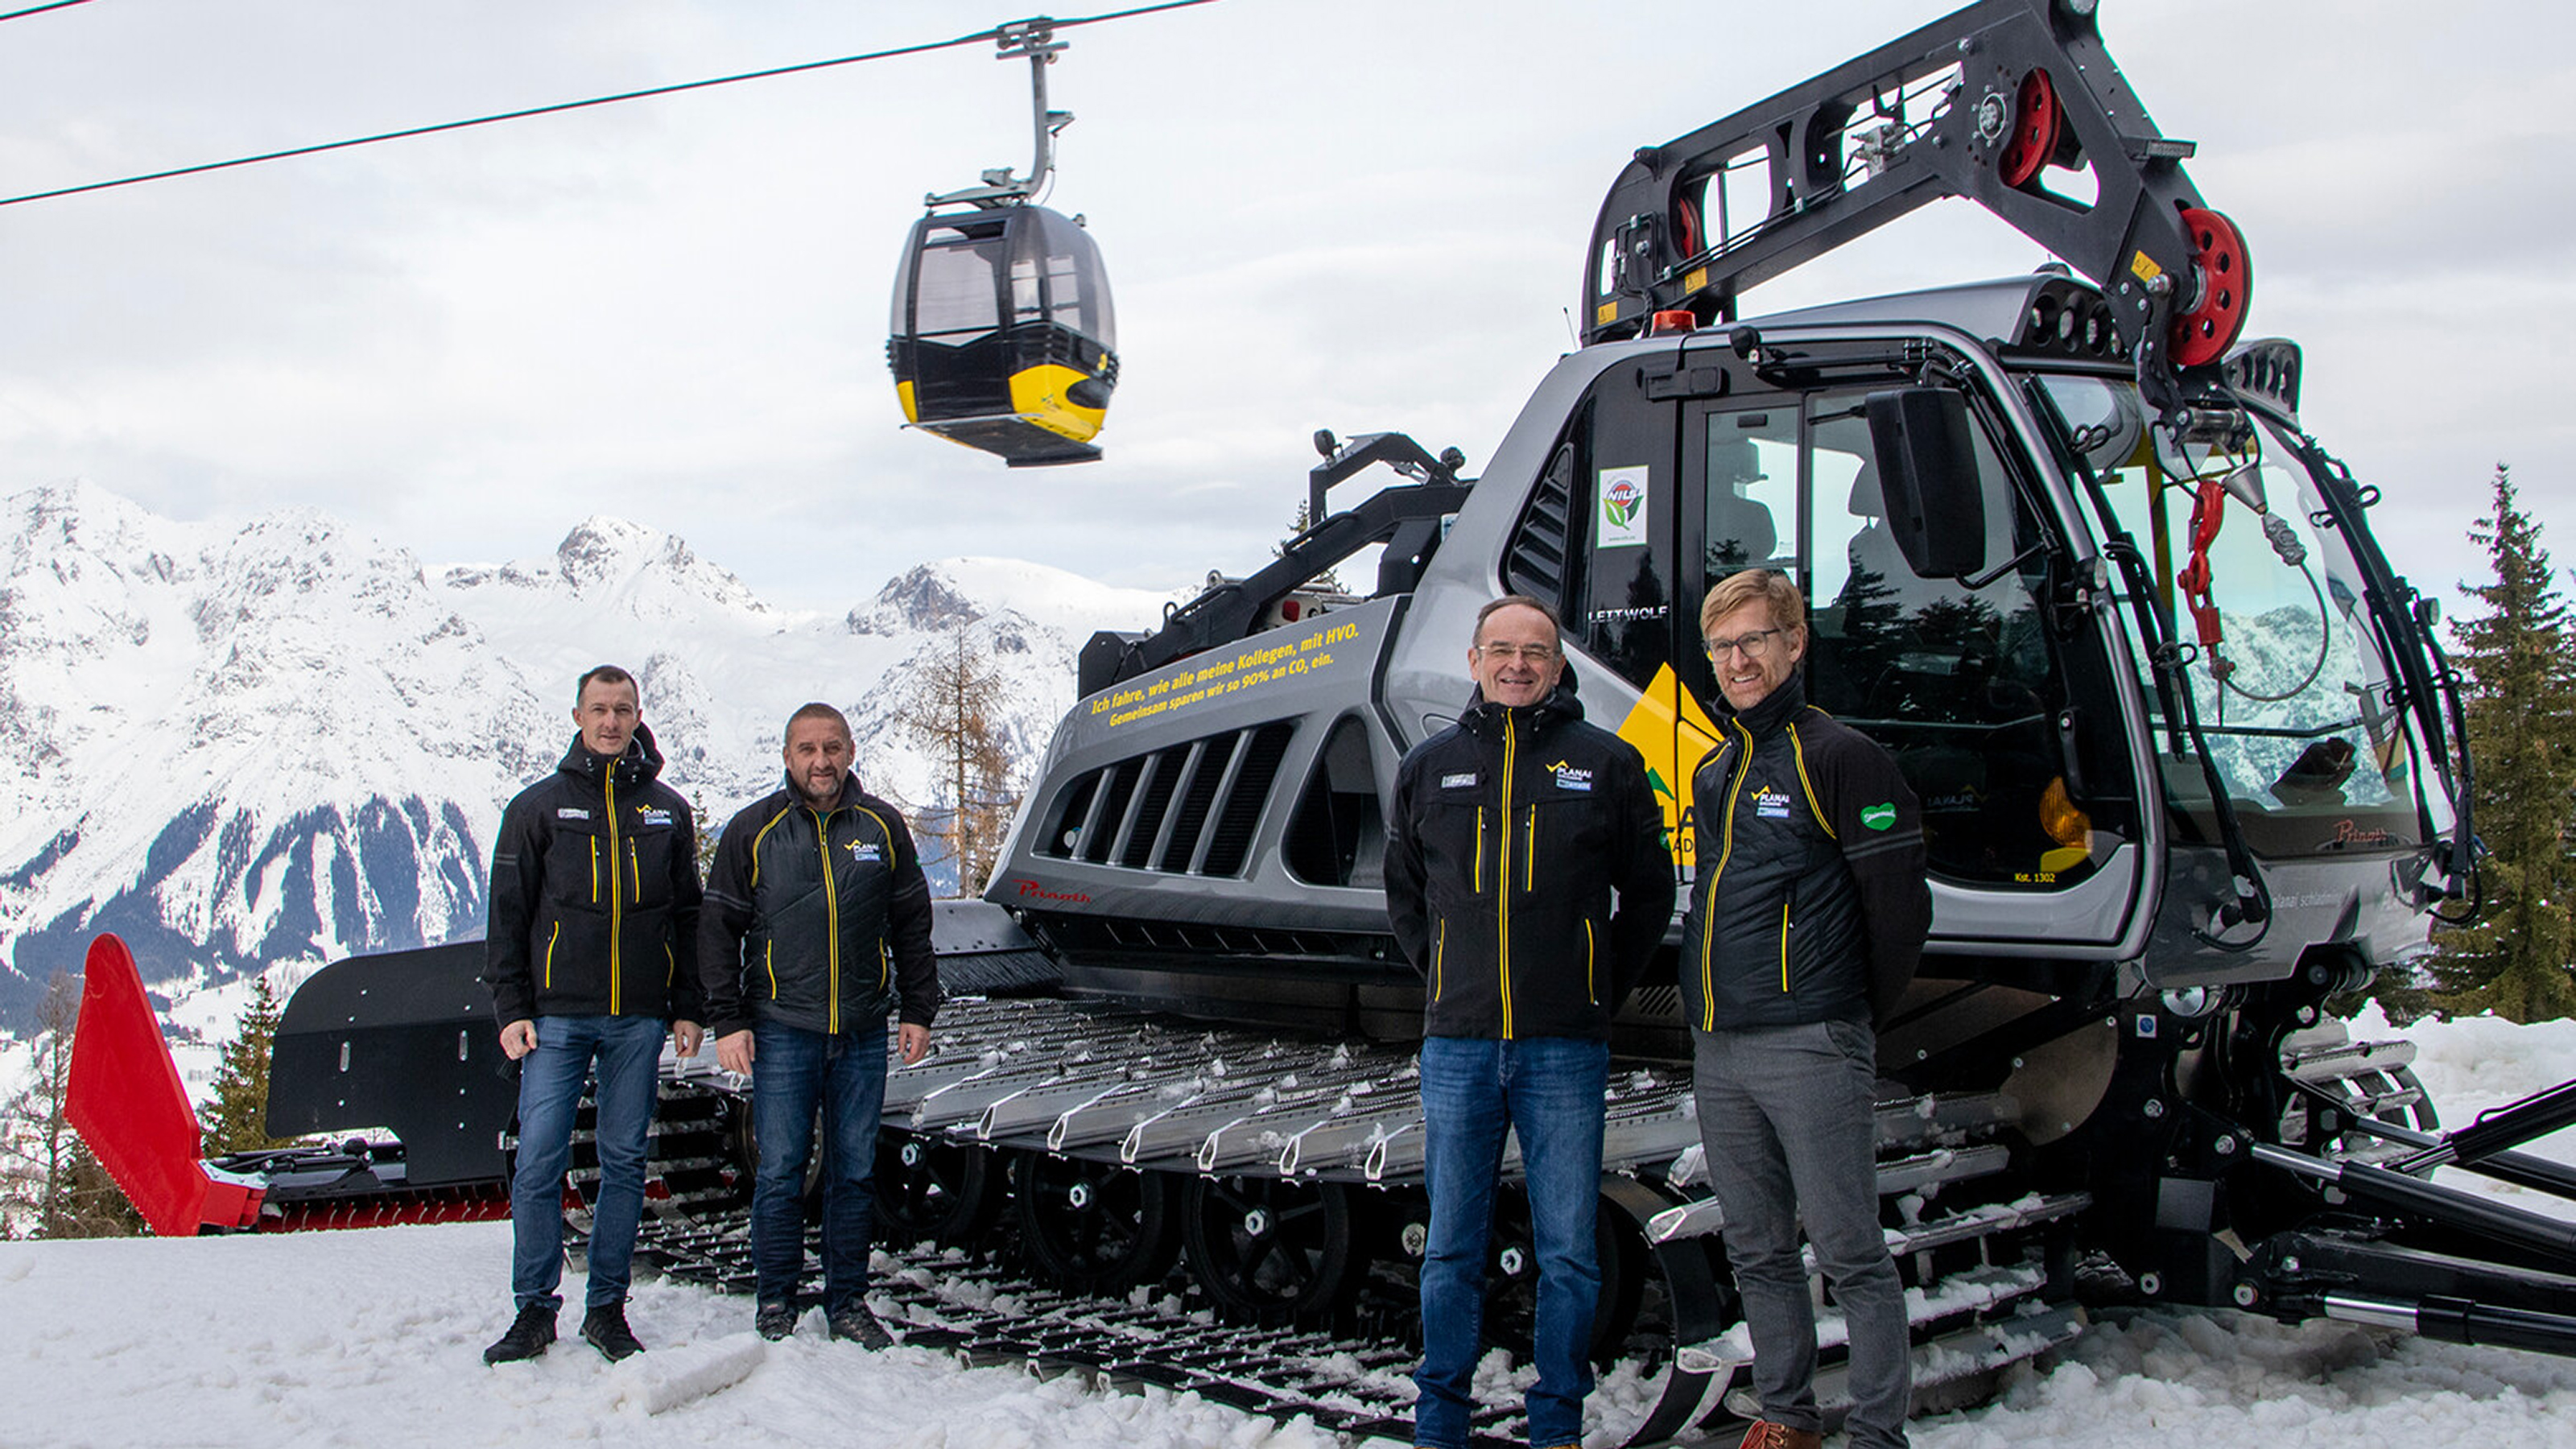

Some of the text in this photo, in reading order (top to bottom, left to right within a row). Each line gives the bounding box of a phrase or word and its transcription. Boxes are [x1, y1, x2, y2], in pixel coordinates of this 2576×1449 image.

[1091, 622, 1360, 715] Ich fahre, wie alle meine Kollegen, mit HVO.
[1109, 700, 1167, 727] Gemeinsam
[1169, 691, 1204, 710] sparen
[1208, 682, 1225, 697] wir
[1226, 679, 1240, 693] so
[1242, 670, 1269, 688] 90%
[1272, 666, 1286, 679] an
[1311, 652, 1334, 669] ein.
[1012, 878, 1092, 904] Prinoth
[2014, 873, 2056, 883] Kst. 1302
